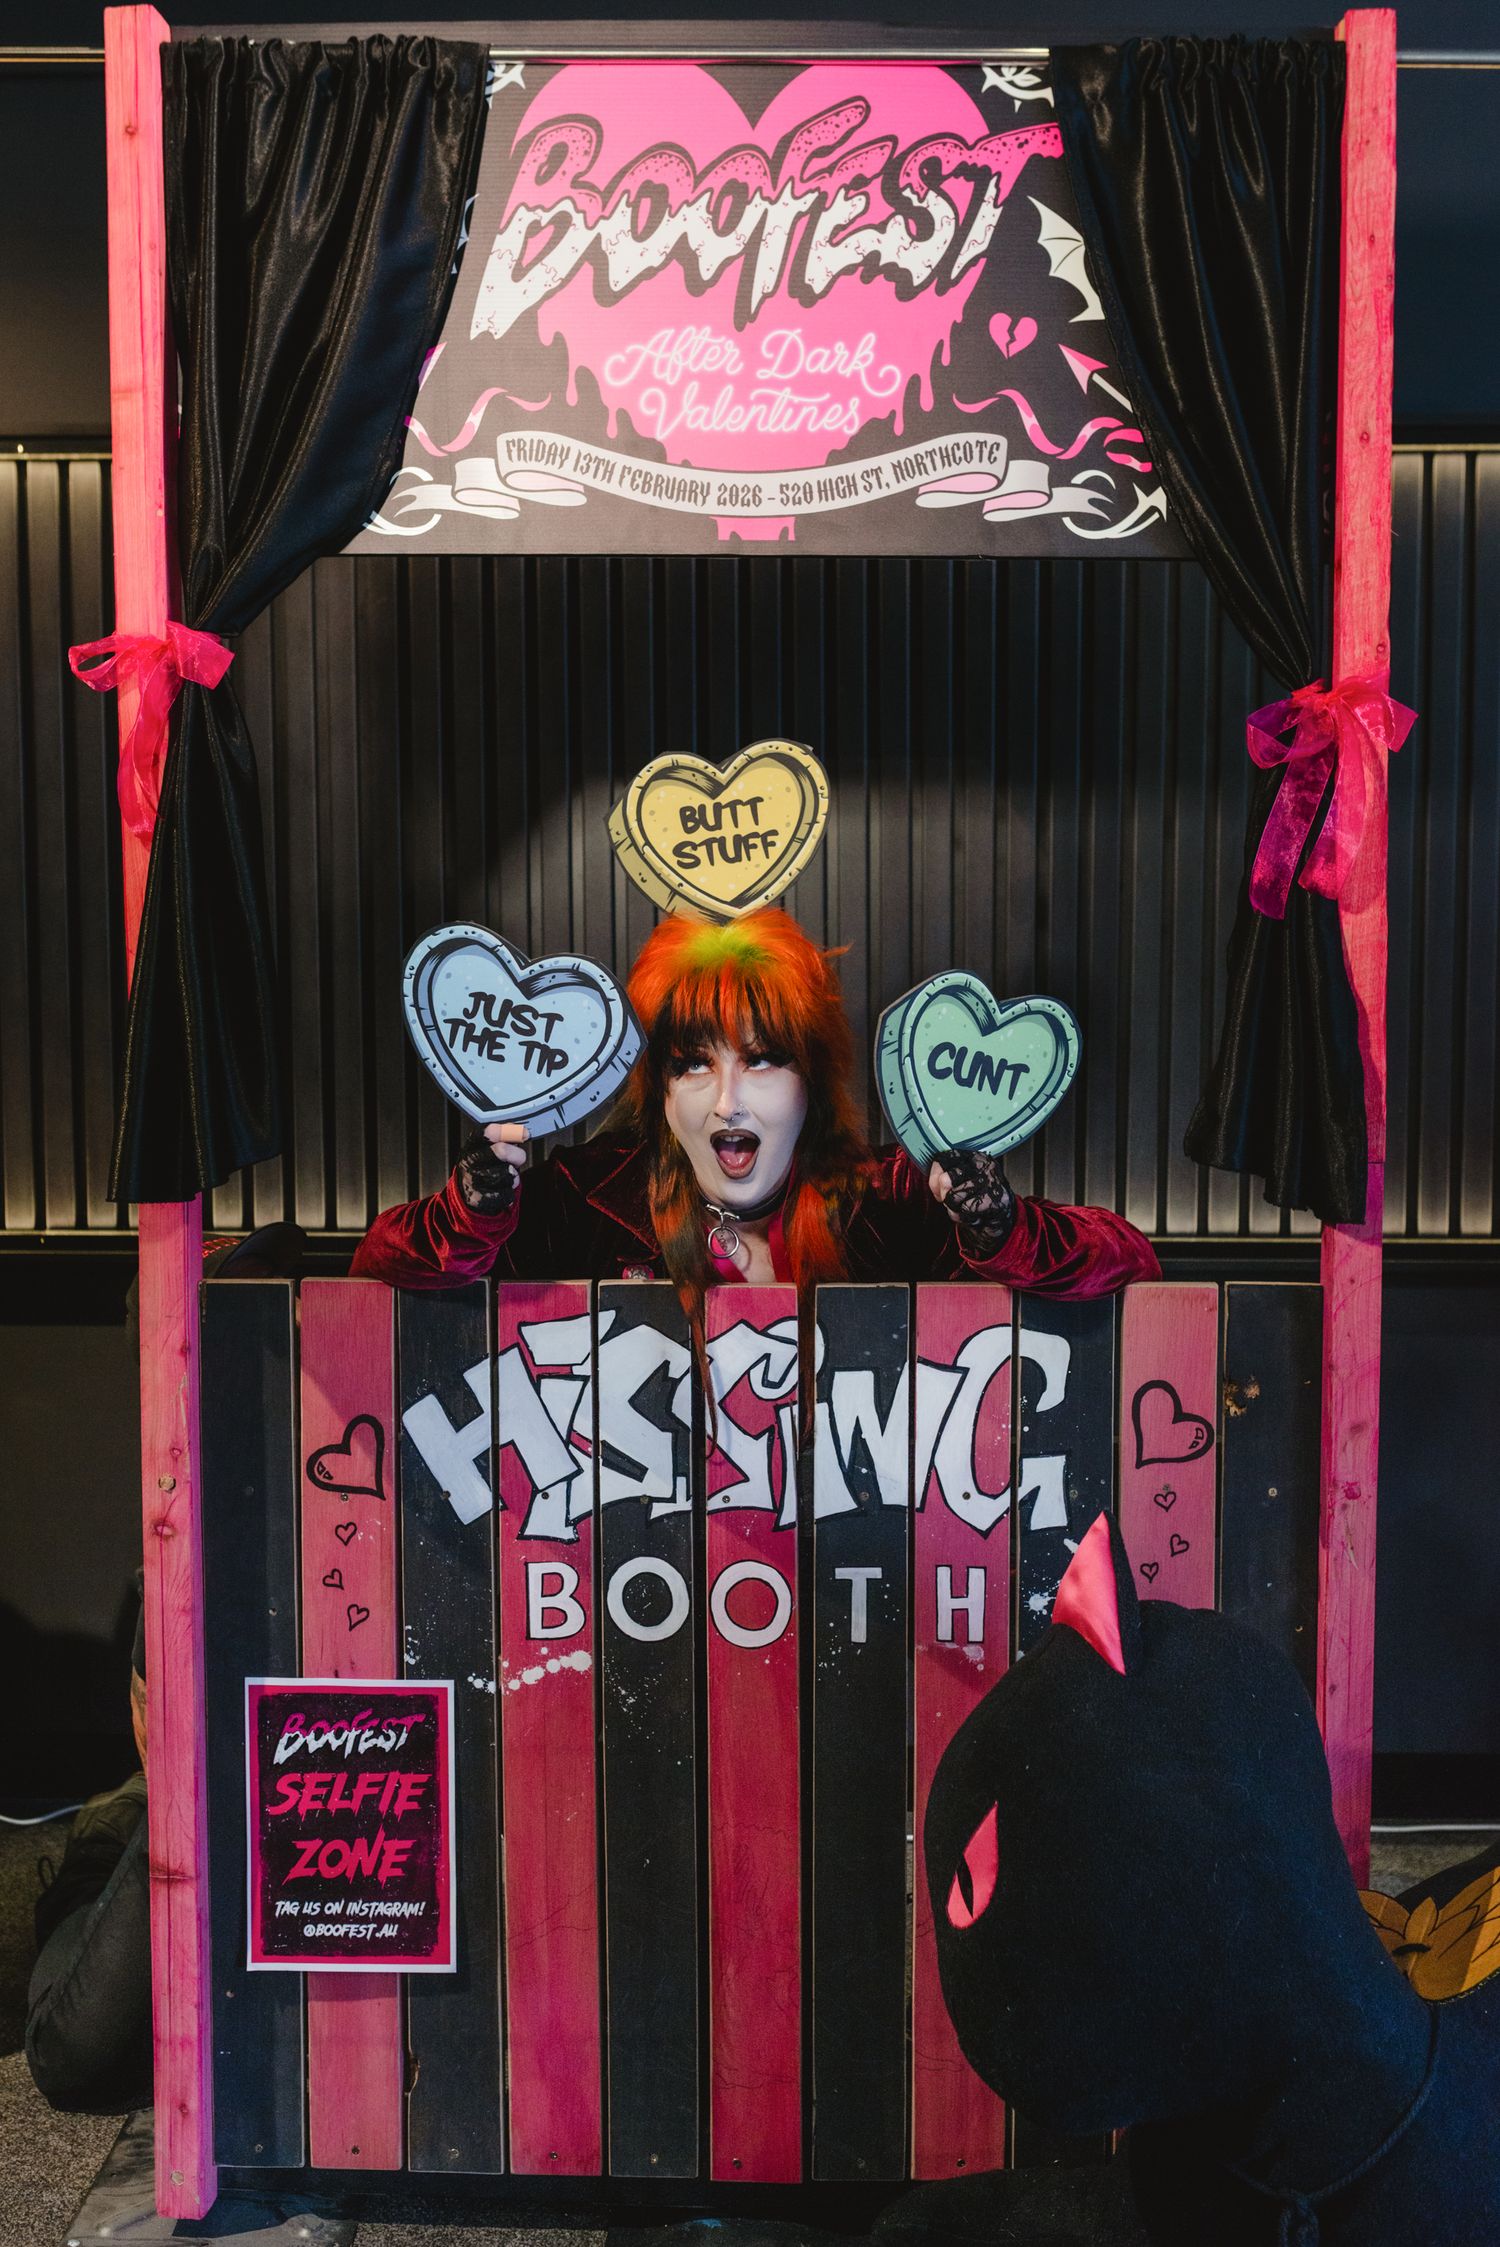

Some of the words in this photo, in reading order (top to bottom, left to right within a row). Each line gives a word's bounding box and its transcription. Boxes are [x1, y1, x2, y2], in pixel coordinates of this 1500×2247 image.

[470, 94, 1064, 340] BOOFEST
[604, 326, 743, 386] After
[757, 328, 901, 397] Dark
[639, 381, 861, 440] Valentines
[506, 438, 570, 469] FRIDAY
[573, 450, 616, 484] 13TH
[619, 465, 711, 507] FEBRUARY
[717, 483, 762, 507] 2026
[779, 482, 813, 506] 520
[817, 472, 859, 503] HIGH
[861, 466, 890, 494] ST,
[891, 439, 1001, 485] NORTHCOTE
[679, 796, 764, 833] BUTT
[672, 830, 779, 869] STUFF
[462, 991, 564, 1038] JUST
[443, 1018, 506, 1063] THE
[518, 1037, 569, 1079] TIP
[926, 1041, 1030, 1101] CUNT
[526, 1556, 986, 1648] BOOTH
[273, 1708, 426, 1765] BOOFEST
[266, 1770, 432, 1822] SELFIE
[282, 1824, 417, 1889] ZONE
[275, 1900, 300, 1918] TAG
[302, 1902, 322, 1914] US
[324, 1900, 344, 1915] ON
[346, 1899, 426, 1918] INSTAGRAM!
